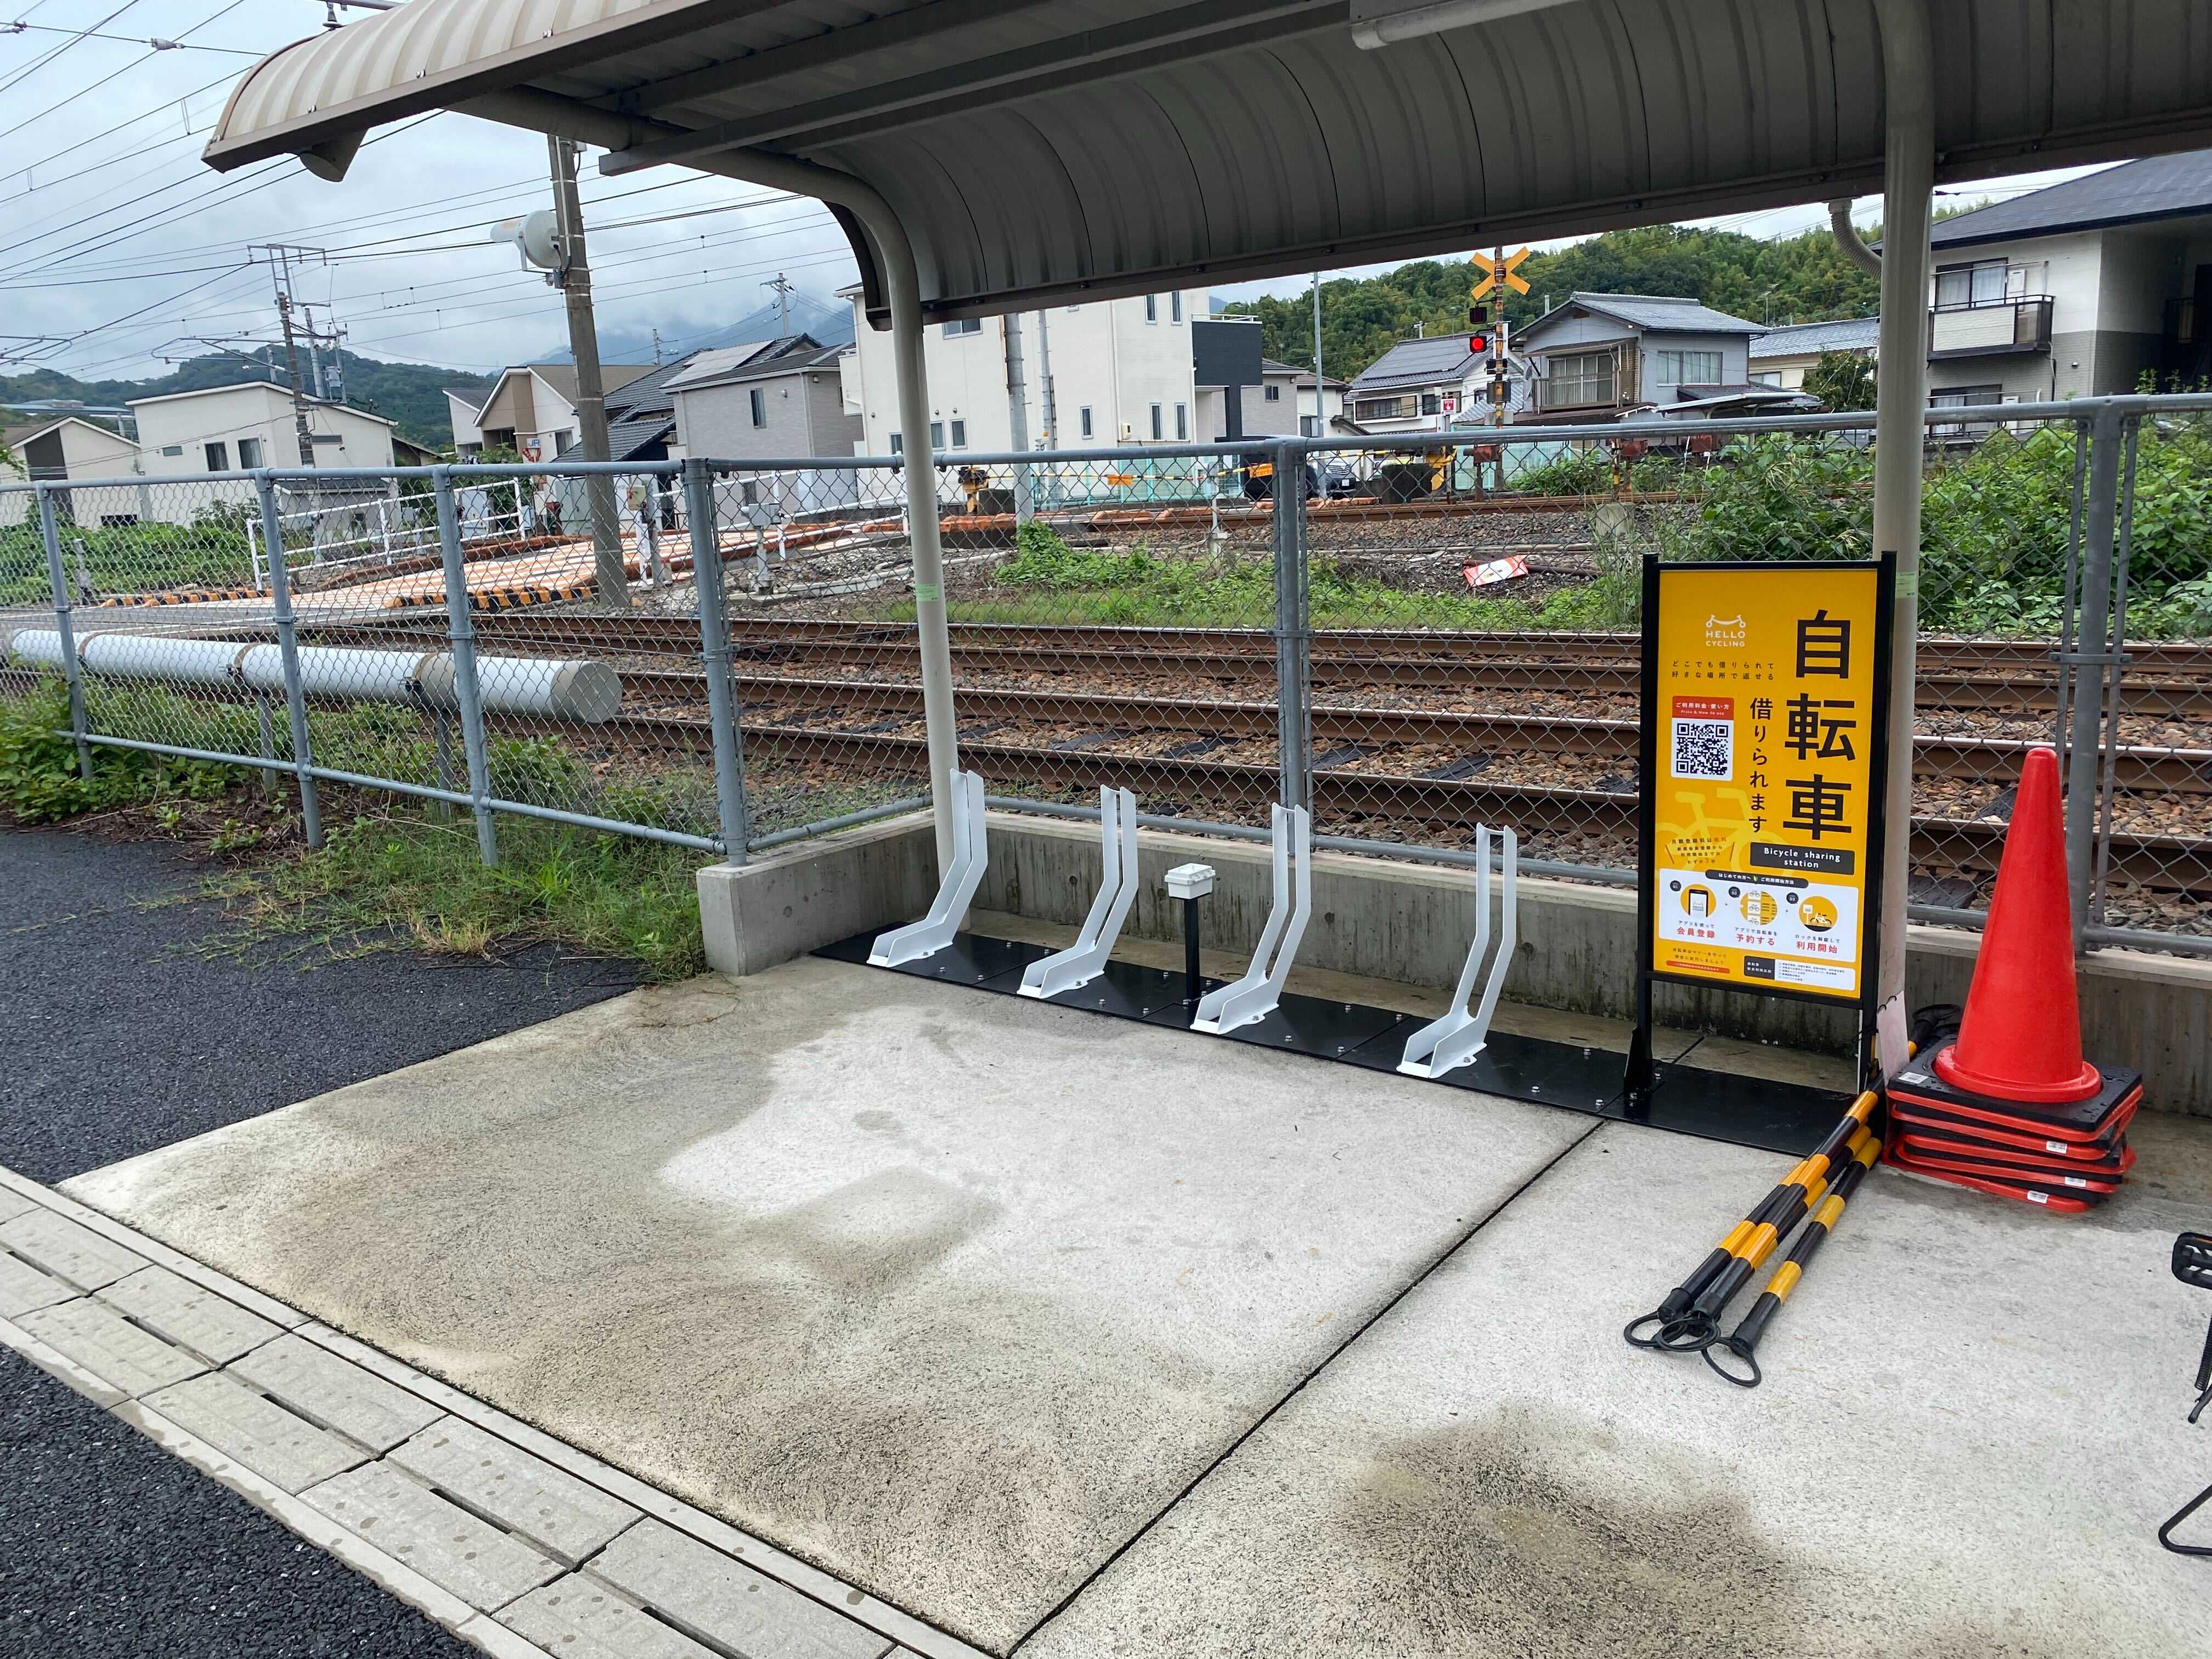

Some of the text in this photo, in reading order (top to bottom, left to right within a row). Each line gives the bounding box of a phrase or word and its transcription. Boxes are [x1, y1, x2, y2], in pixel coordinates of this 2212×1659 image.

[1673, 661, 1774, 669] どこでも借りられて
[1672, 671, 1774, 680] 好きな場所で返せる
[1783, 610, 1857, 840] 自転車
[1748, 697, 1773, 833] 借りられます
[1764, 847, 1841, 862] Bicycle sharing
[1784, 860, 1819, 868] station
[1678, 920, 1714, 928] アプリを使って
[1677, 927, 1716, 938] 会員登録
[1735, 927, 1778, 936] アプリで自転車を
[1736, 934, 1775, 946] 予約する
[1796, 941, 1838, 953] 利用開始
